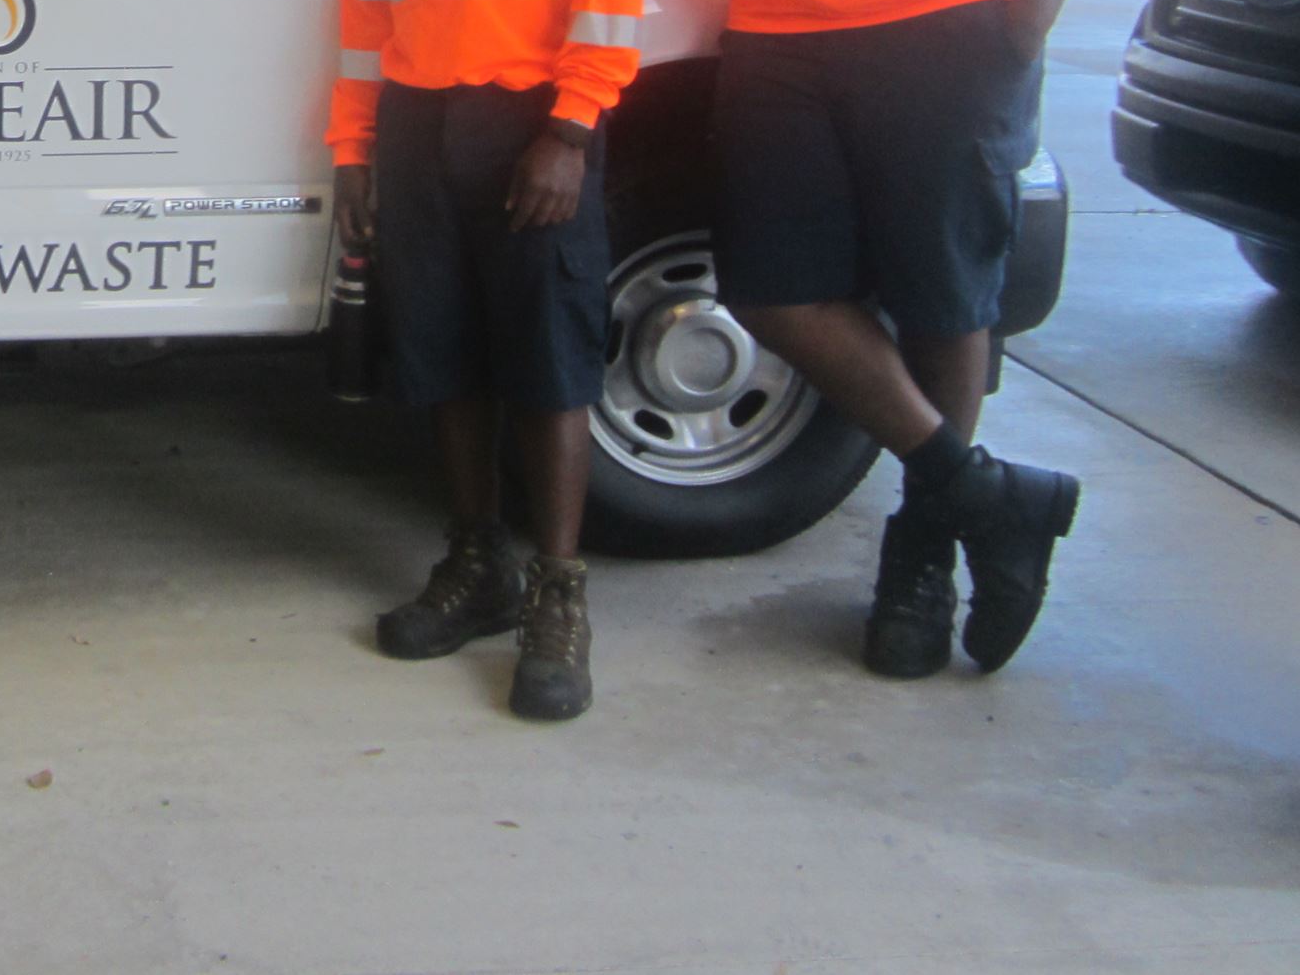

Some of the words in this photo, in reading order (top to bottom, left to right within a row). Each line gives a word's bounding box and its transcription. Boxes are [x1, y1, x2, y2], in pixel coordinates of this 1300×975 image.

[14, 61, 40, 74] OF
[104, 199, 157, 218] 6.7L
[170, 200, 236, 212] POWER
[241, 198, 318, 211] STROK
